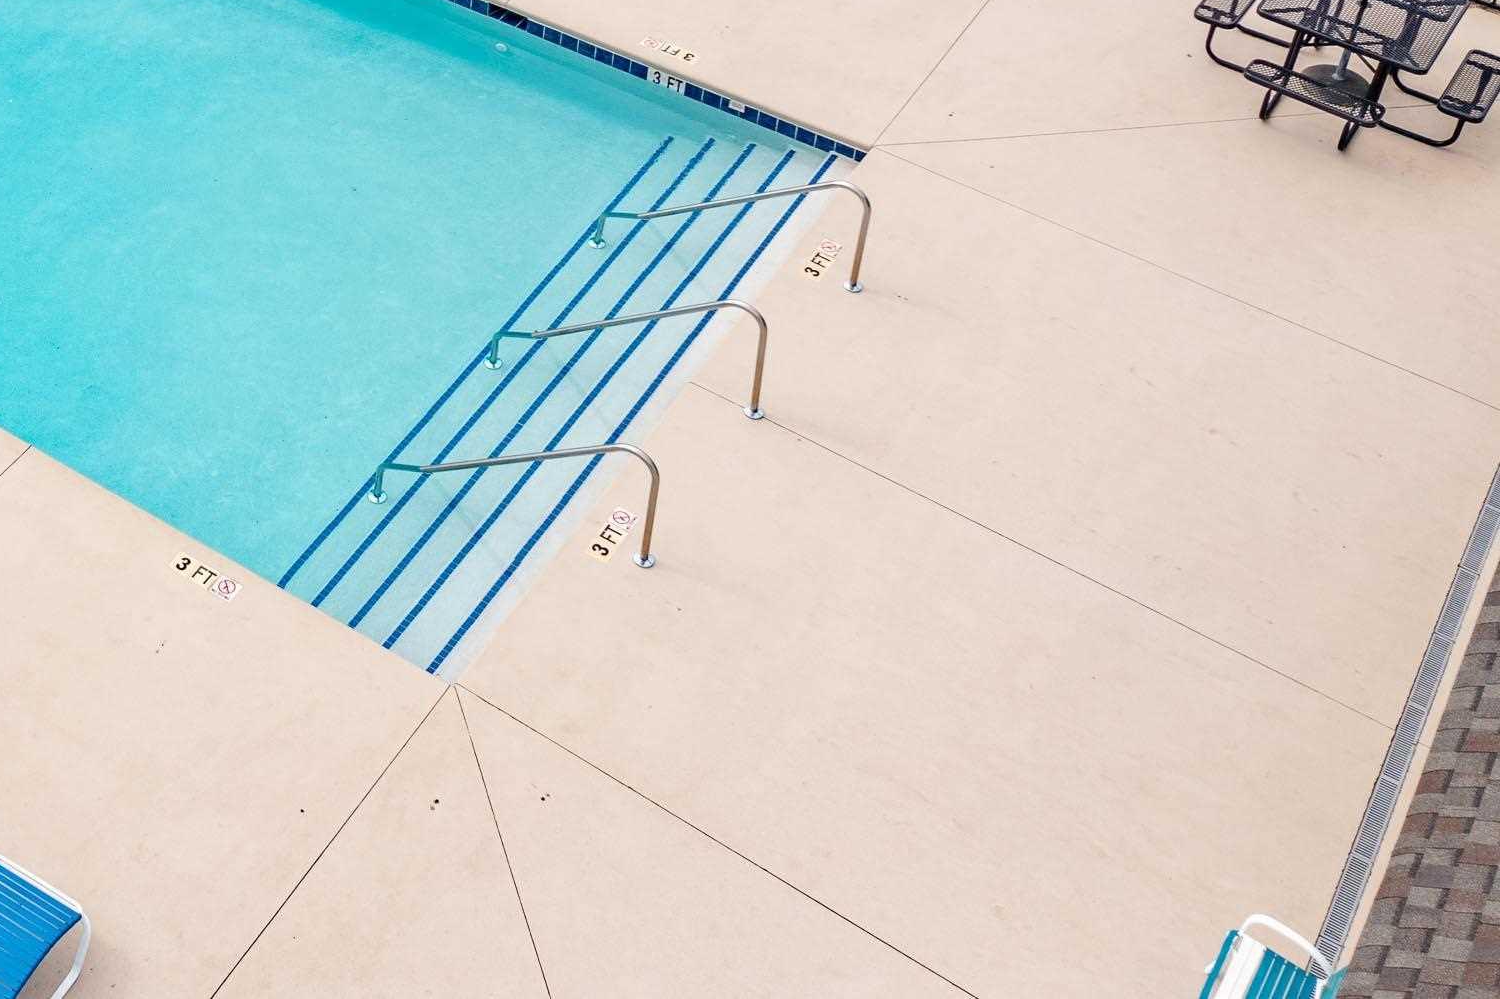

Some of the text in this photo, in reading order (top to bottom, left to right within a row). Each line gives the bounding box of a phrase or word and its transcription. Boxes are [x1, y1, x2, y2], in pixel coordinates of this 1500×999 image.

[652, 71, 683, 93] 3 FT
[804, 252, 832, 277] 3 FT
[592, 524, 622, 556] 3 FT
[175, 557, 217, 585] 3 FT
